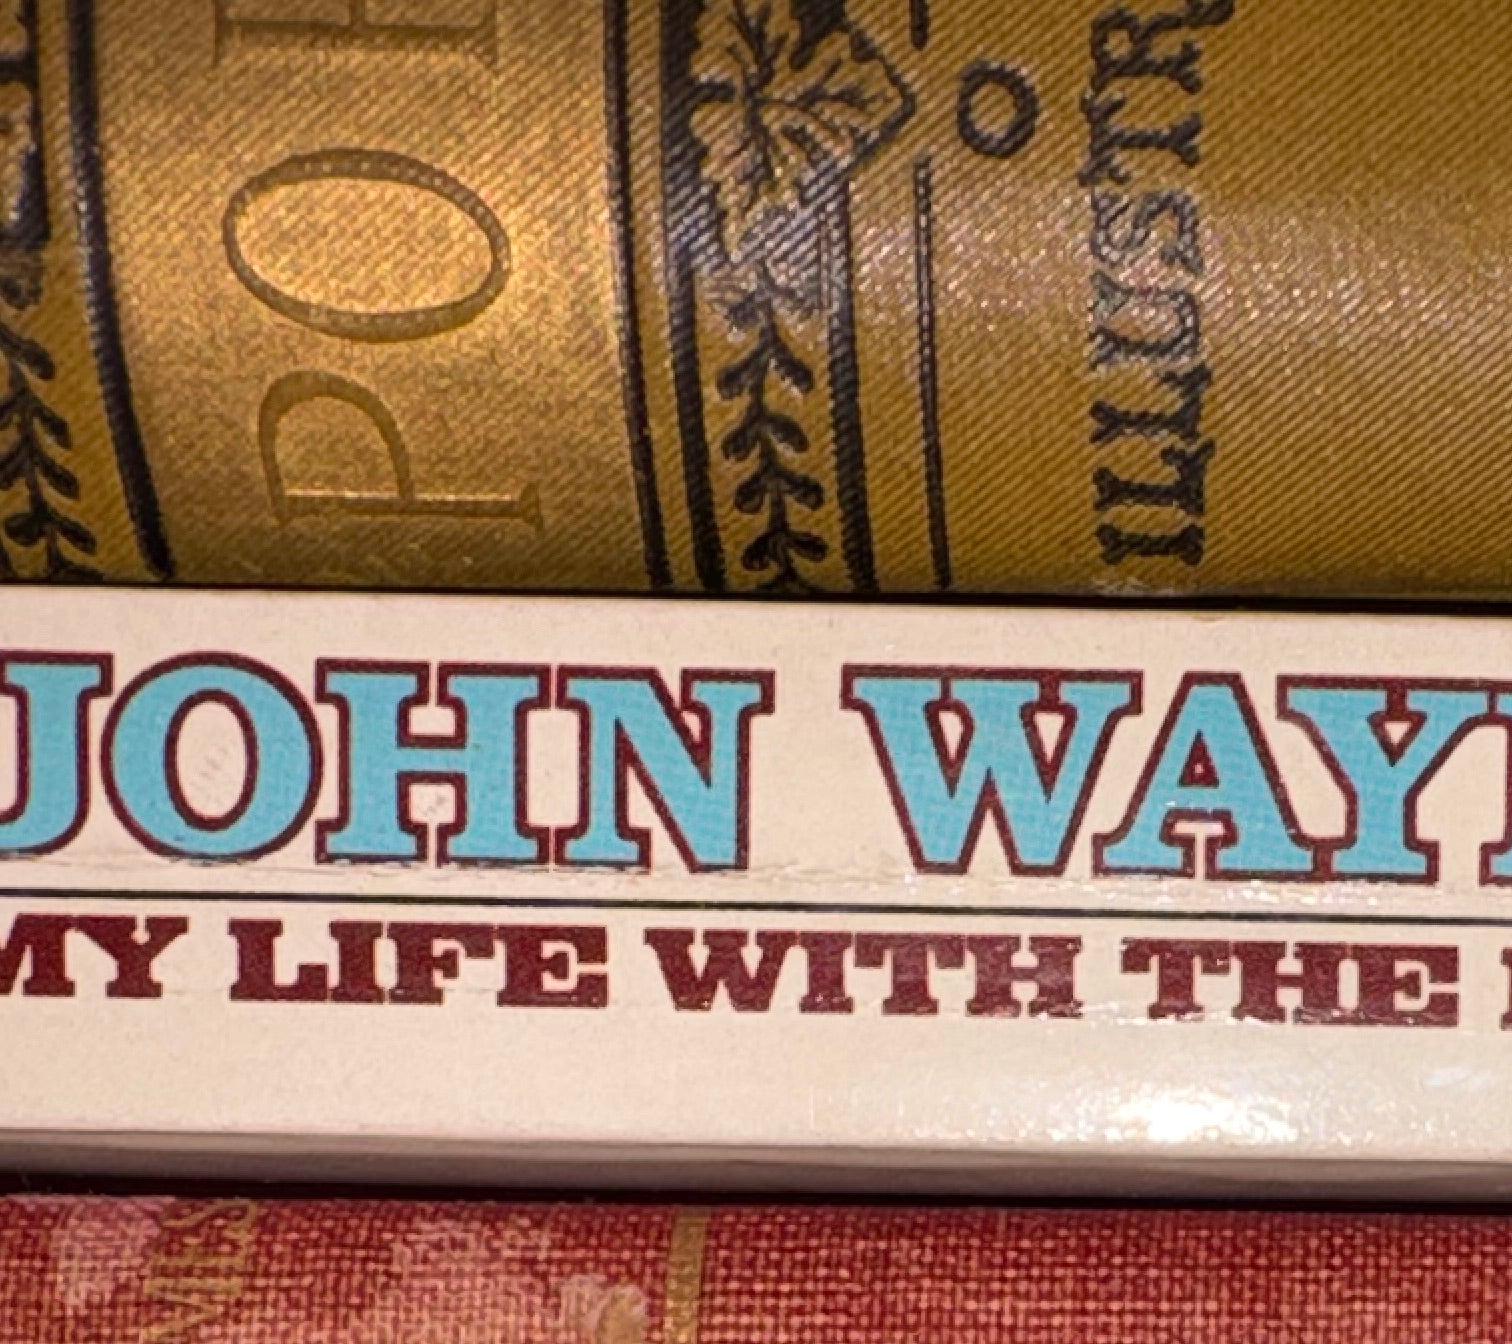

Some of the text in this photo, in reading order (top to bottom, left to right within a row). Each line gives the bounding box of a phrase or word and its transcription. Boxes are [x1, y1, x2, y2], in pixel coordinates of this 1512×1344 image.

[0, 650, 776, 873] JOHN
[229, 918, 608, 1008] LIFE
[645, 927, 1082, 1017] WITH
[1121, 936, 1459, 1027] THE
